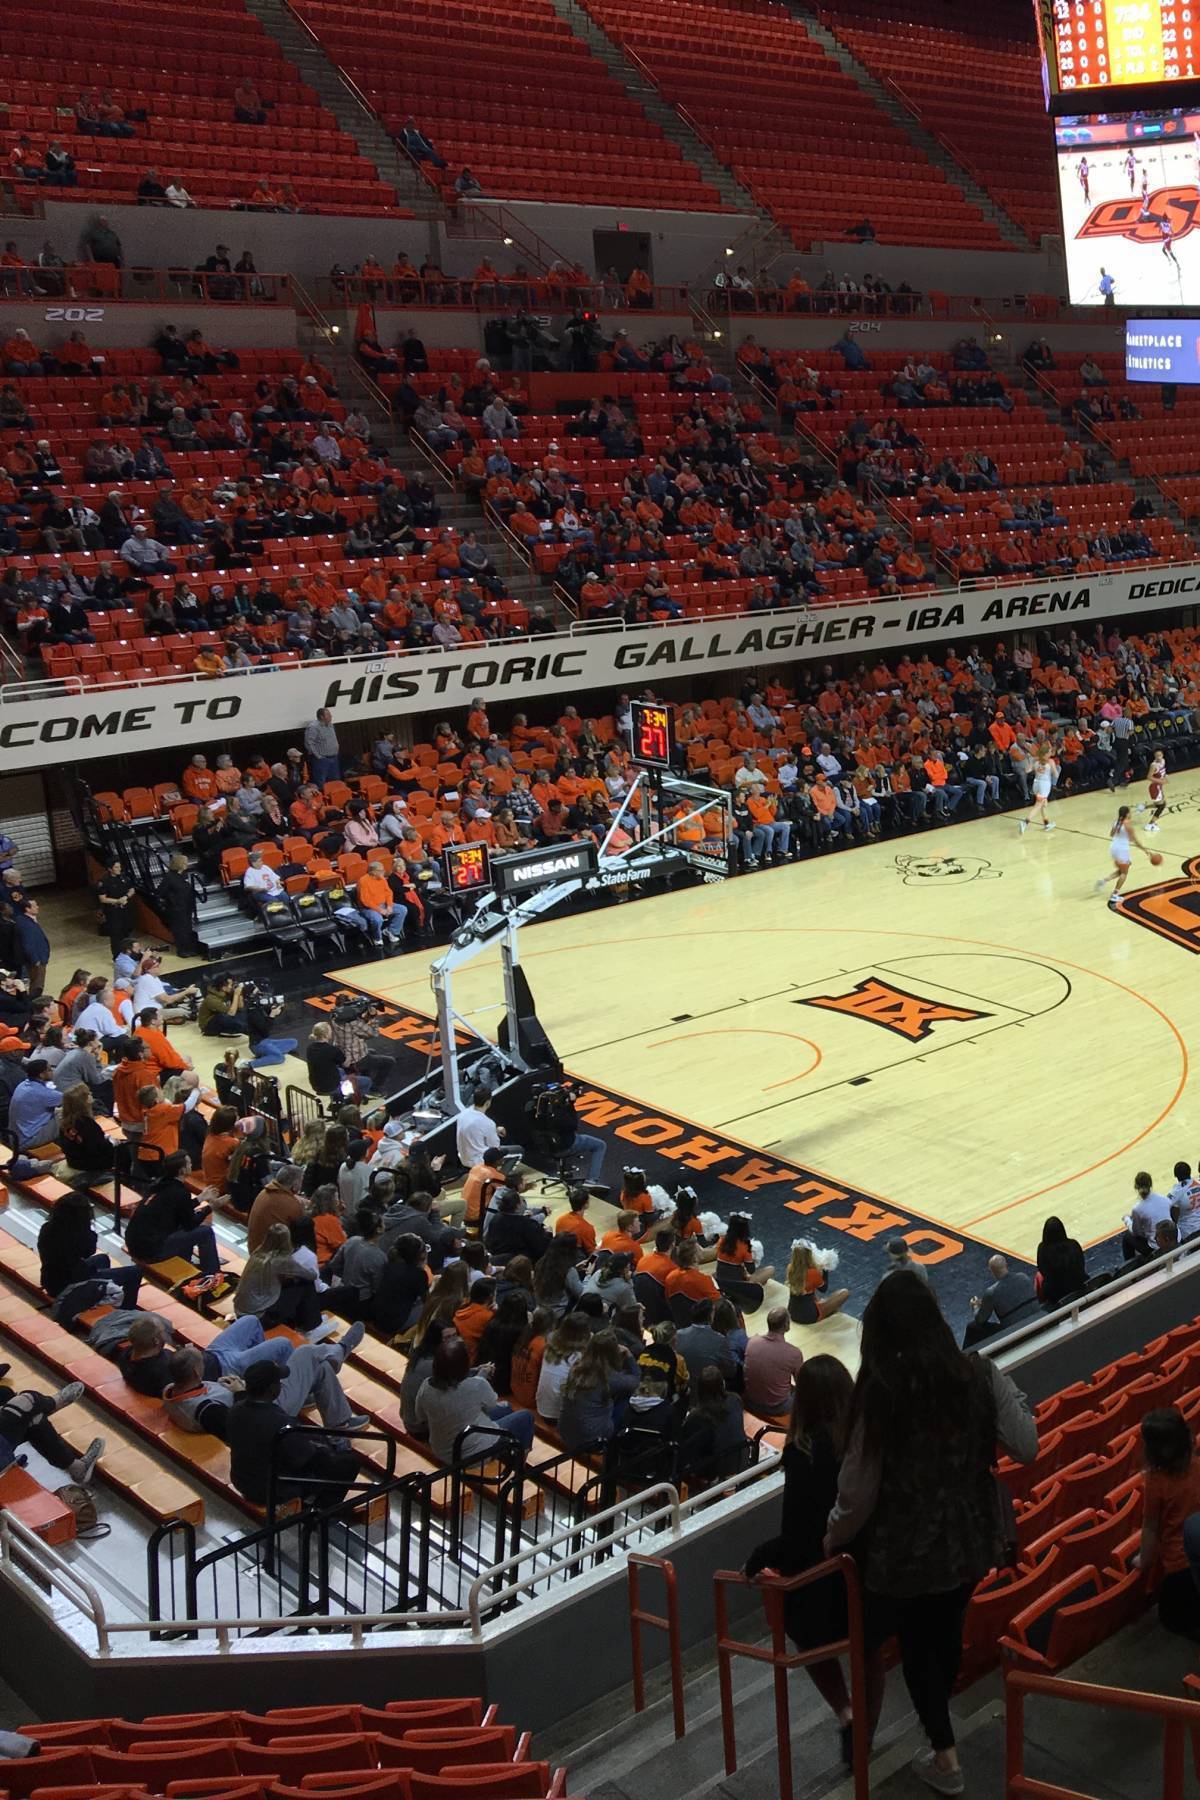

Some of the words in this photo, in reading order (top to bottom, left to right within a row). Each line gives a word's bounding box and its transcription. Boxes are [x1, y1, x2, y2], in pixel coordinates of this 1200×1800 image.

[45, 308, 104, 322] 202
[849, 321, 881, 333] 204
[1, 706, 156, 748] COME
[174, 695, 242, 724] TO
[325, 650, 588, 708] HISTORIC
[981, 588, 1090, 623] ARENA
[644, 709, 666, 726] 7:34
[641, 726, 666, 756] 27
[456, 850, 483, 865] 7:34
[456, 866, 480, 886] 27
[513, 855, 580, 882] NISSAN
